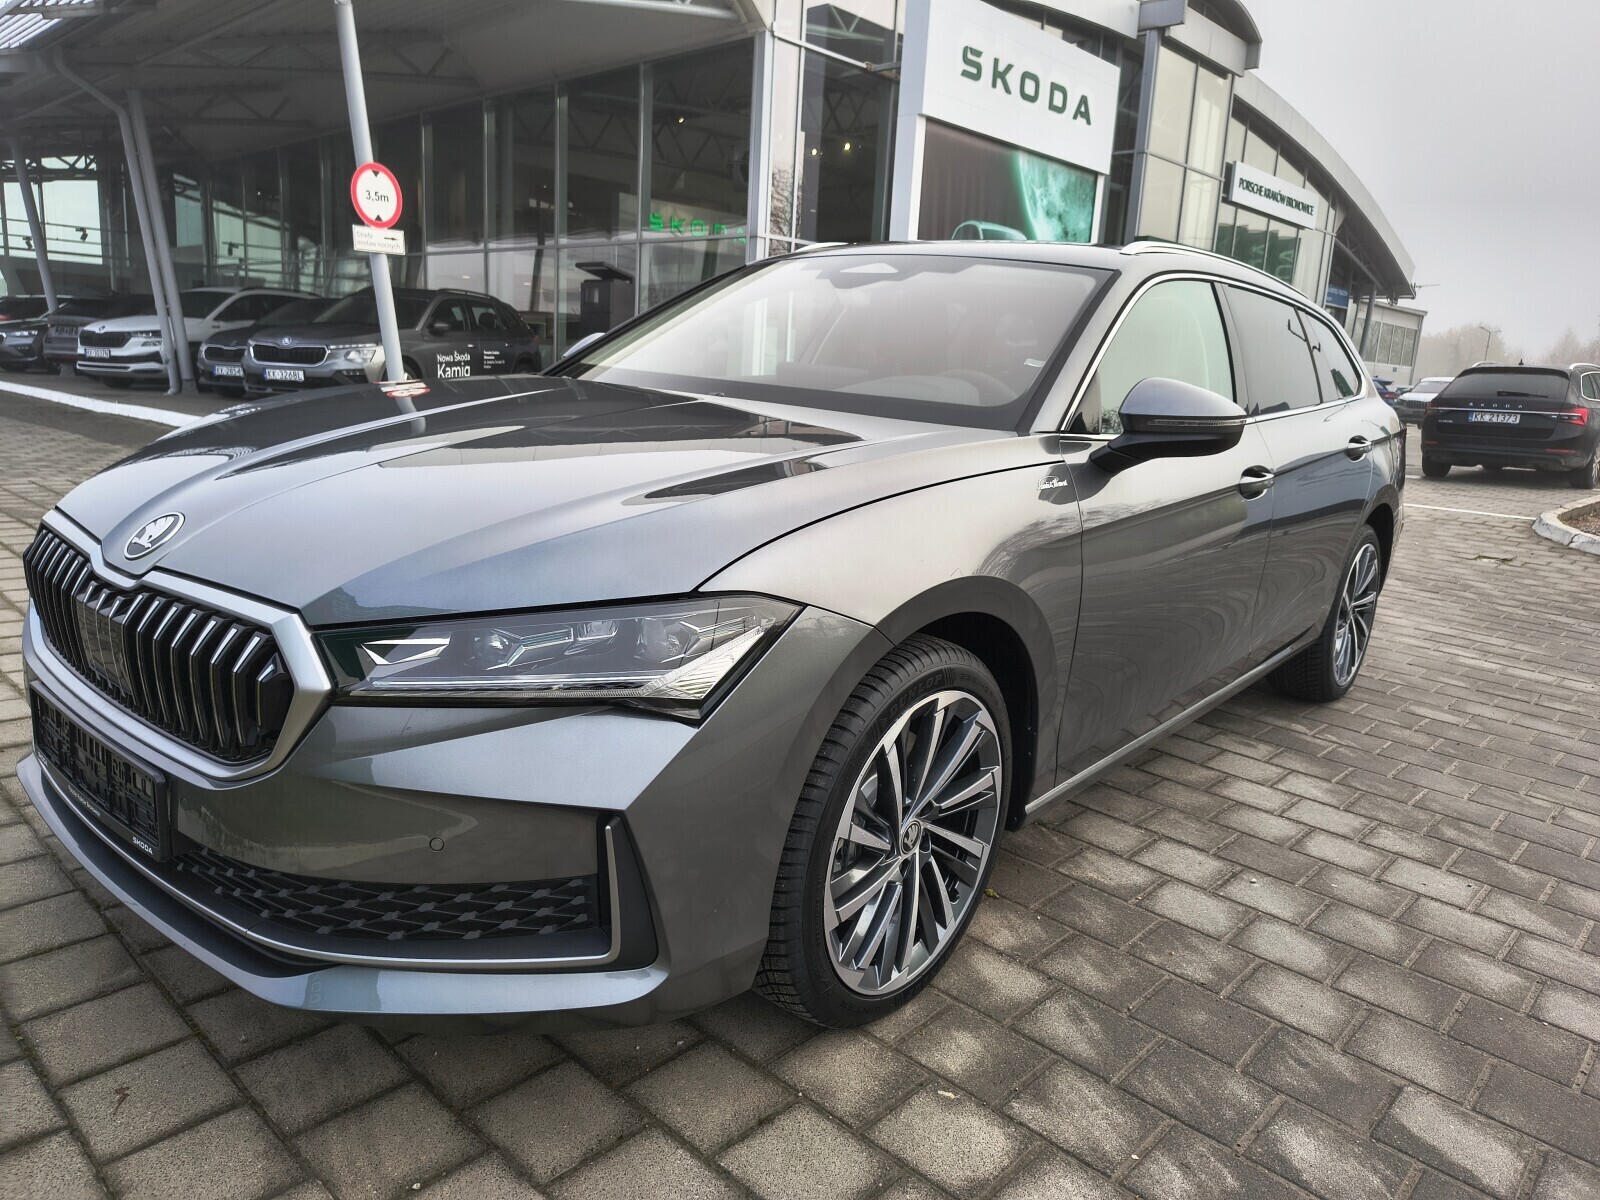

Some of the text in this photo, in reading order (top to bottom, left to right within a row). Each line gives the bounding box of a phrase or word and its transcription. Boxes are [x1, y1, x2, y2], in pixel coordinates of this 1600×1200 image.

[961, 45, 1091, 126] SKODA
[365, 189, 389, 202] 3,5m
[1239, 177, 1315, 216] PORSCHE KRAKÓW BRONOWICE
[437, 353, 453, 363] Nowa
[454, 350, 471, 361] Škoda
[1473, 412, 1519, 423] KK 21373
[888, 672, 944, 719] DUNLOP
[132, 836, 154, 855] SKODA
